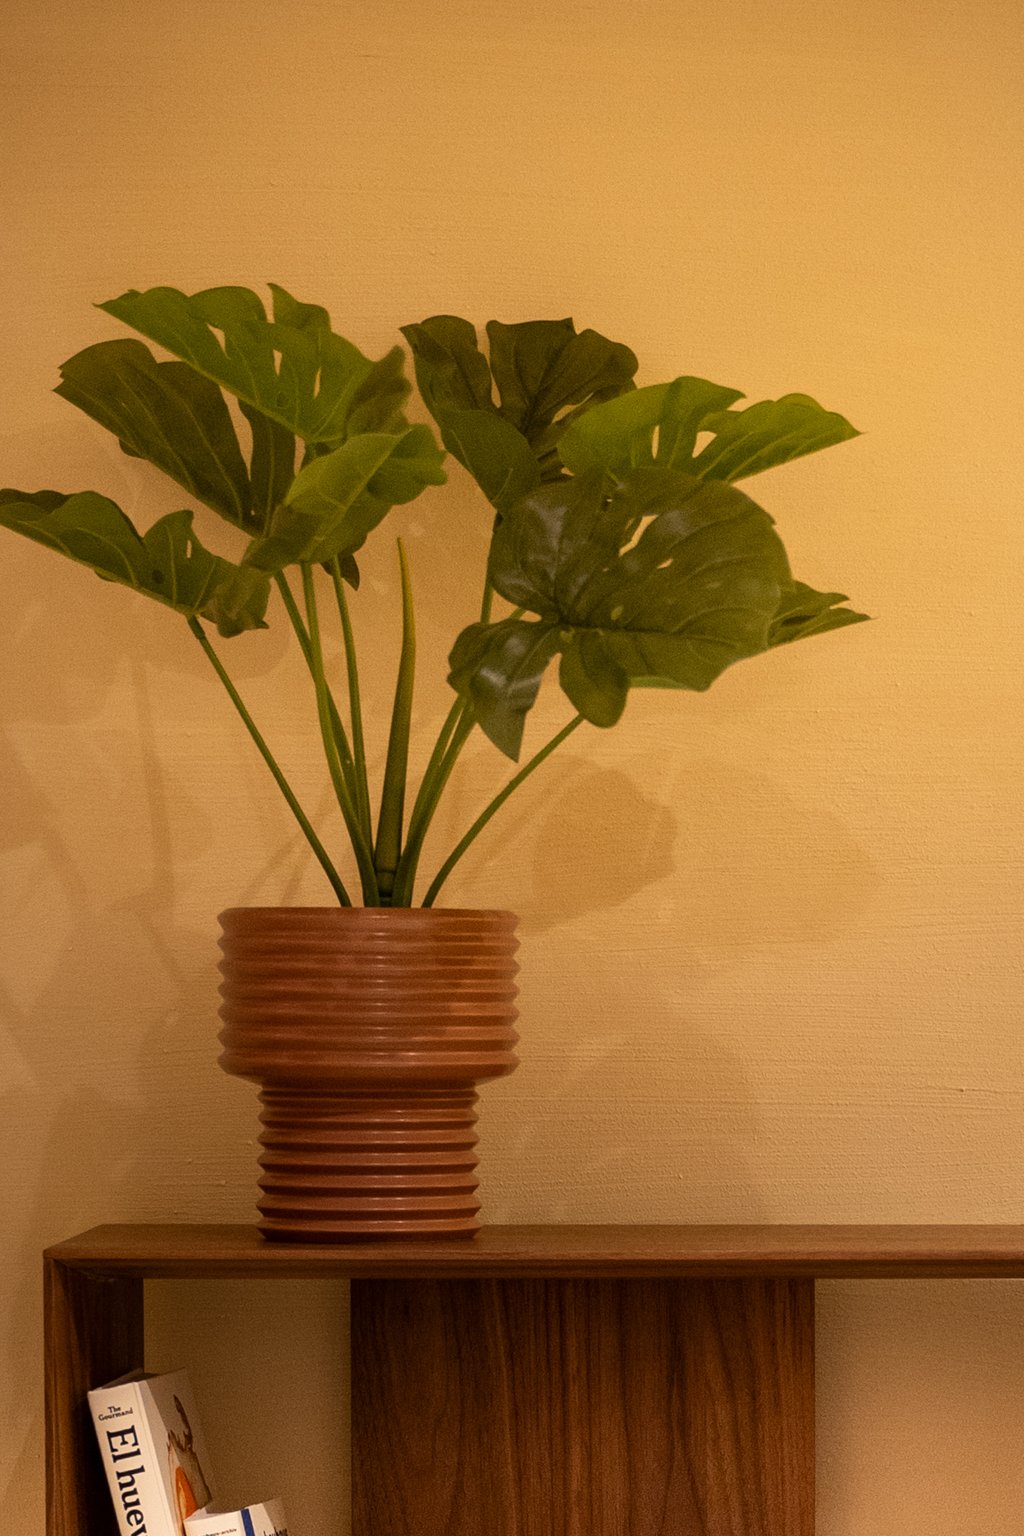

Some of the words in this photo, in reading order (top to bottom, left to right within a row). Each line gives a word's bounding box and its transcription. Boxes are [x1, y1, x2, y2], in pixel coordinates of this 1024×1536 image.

[98, 1407, 133, 1421] Gourmand
[107, 1405, 121, 1414] The
[106, 1425, 141, 1463] El
